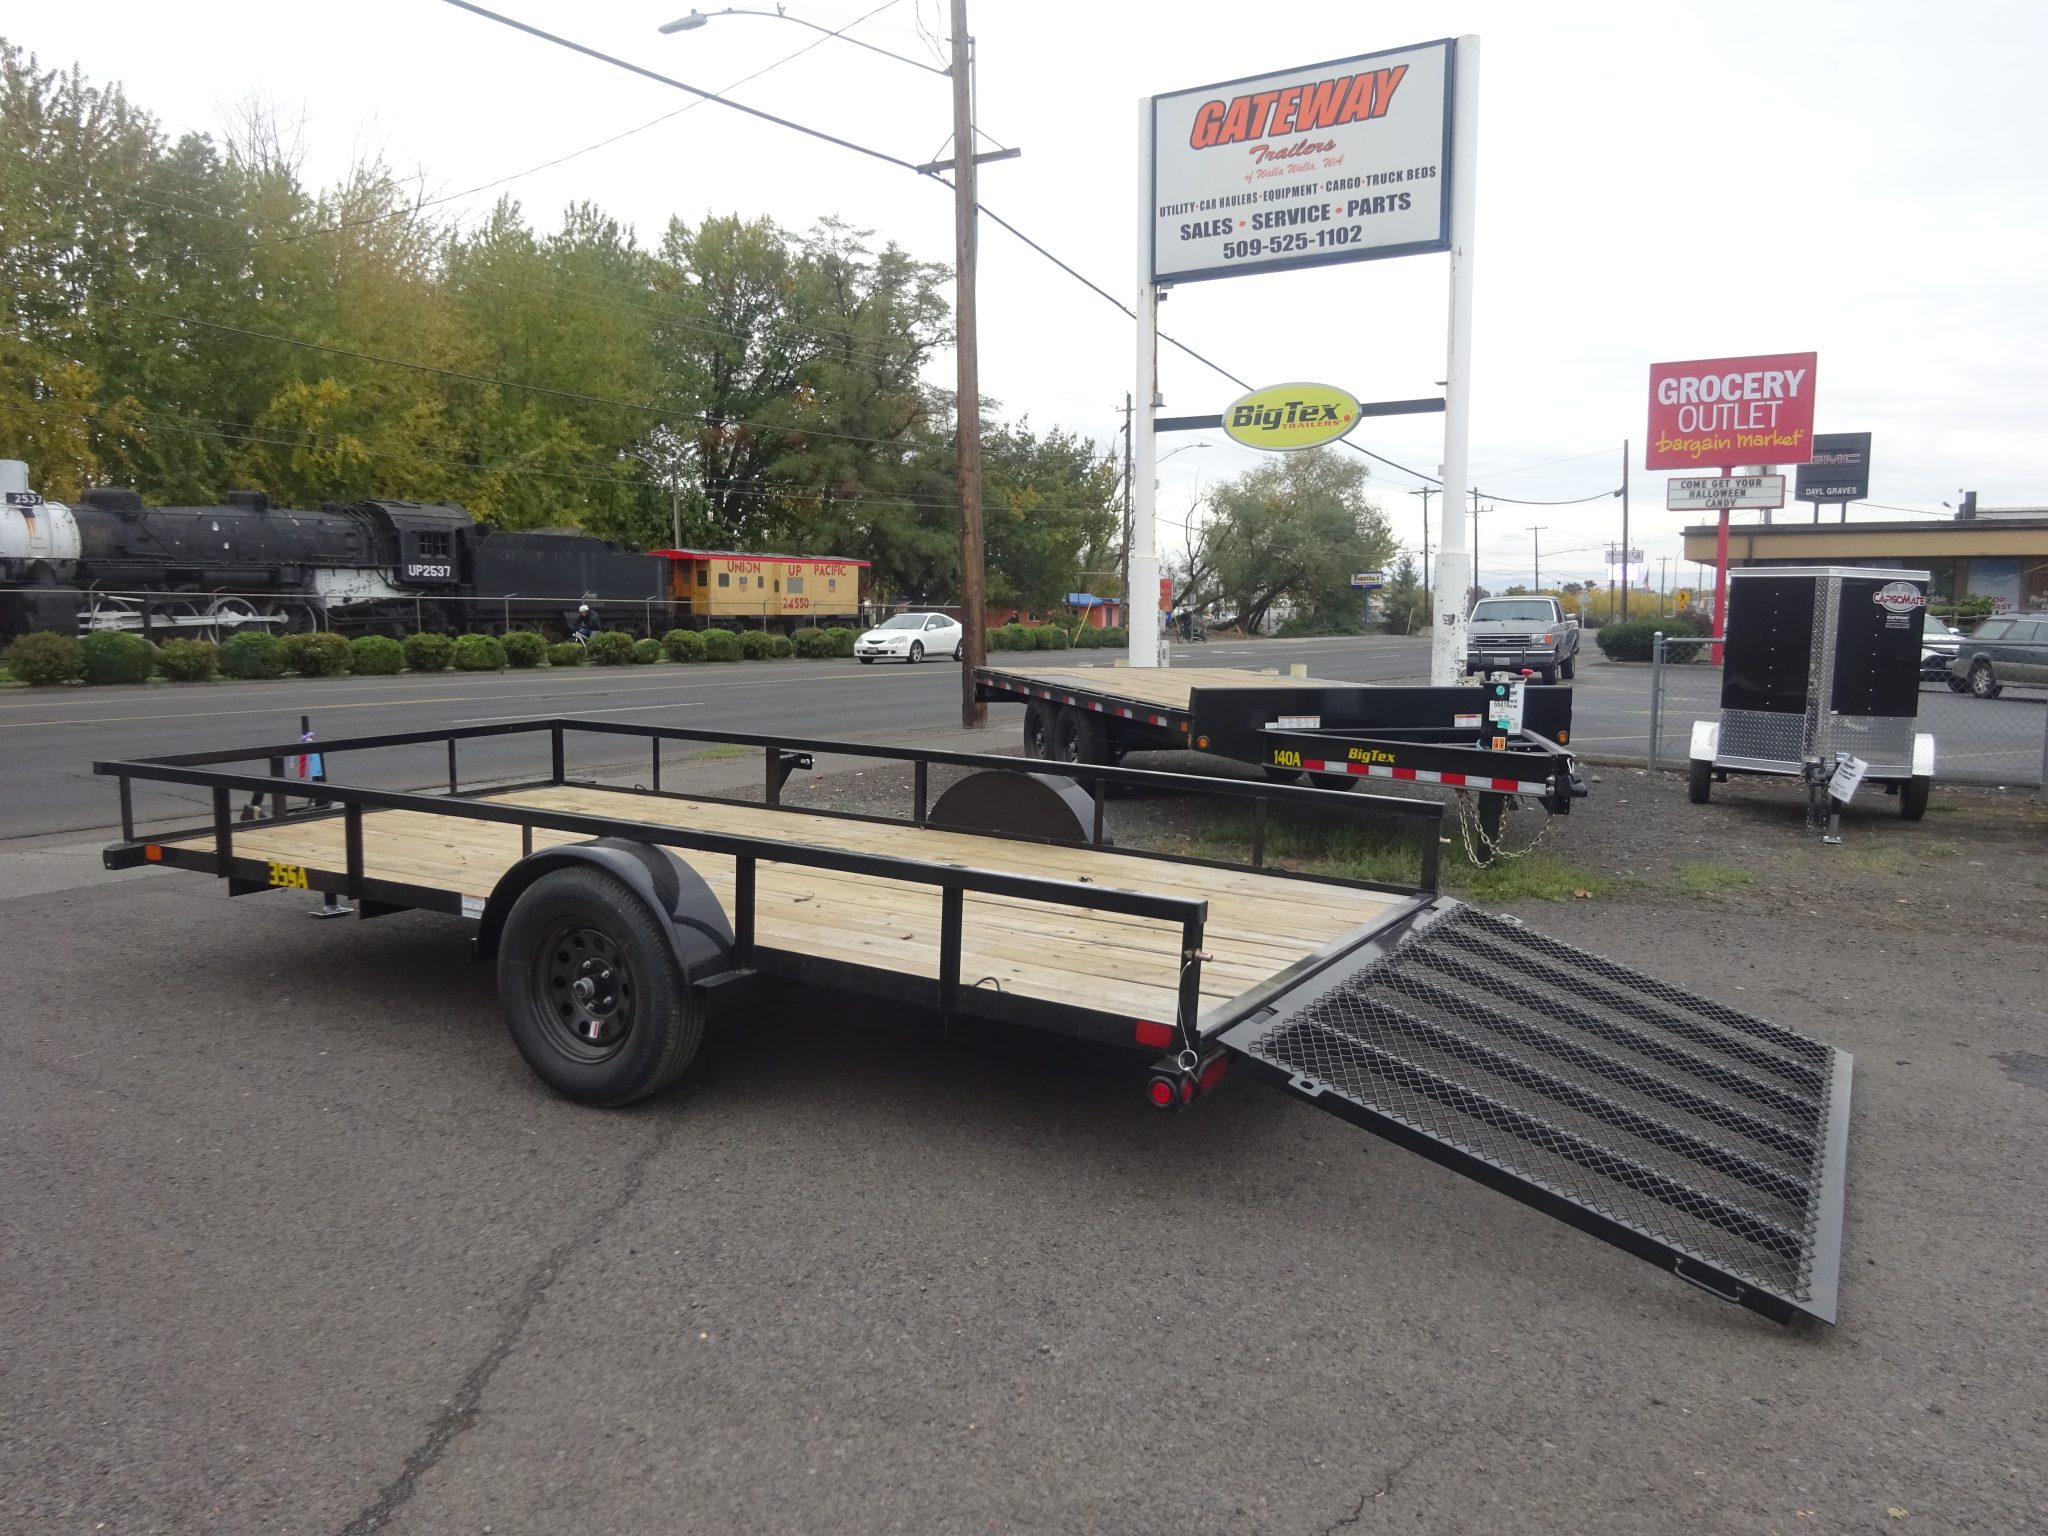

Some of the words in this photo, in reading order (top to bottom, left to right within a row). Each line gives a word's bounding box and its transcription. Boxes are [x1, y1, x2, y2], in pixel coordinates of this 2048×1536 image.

[1190, 64, 1409, 150] GATEWAY
[1249, 139, 1336, 165] Trailers
[1244, 170, 1254, 184] of
[1256, 167, 1284, 179] Walla
[1323, 155, 1344, 168] WA
[1159, 201, 1195, 217] UTILITY
[1199, 199, 1217, 211] CAR
[1219, 192, 1258, 209] HAULERS
[1263, 183, 1319, 202] EQUIPMENT
[1326, 176, 1361, 192] CARGO
[1366, 170, 1404, 187] TRUCK
[1406, 165, 1437, 181] BEDS
[1180, 217, 1233, 241] SALES
[1251, 203, 1331, 231] SERVICE
[1347, 192, 1411, 217] PARTS
[1223, 225, 1363, 260] 509-525-1102
[1657, 368, 1806, 405] GROCERY
[1232, 401, 1341, 430] BigTex
[1282, 419, 1340, 430] TRAILERS
[1678, 400, 1783, 433] OUTLET
[1655, 430, 1731, 459] bargain
[1736, 429, 1803, 447] market
[1811, 453, 1861, 465] GMC
[1680, 480, 1707, 489] COME
[1711, 479, 1730, 488] GET
[1736, 478, 1762, 488] YOUR
[1805, 487, 1825, 496] DAYL
[1826, 486, 1857, 495] GRAVES
[14, 494, 42, 504] 2537
[1689, 488, 1747, 498] HALLOWEEN
[1705, 499, 1736, 508] CANDY
[408, 564, 451, 577] UP2537
[727, 560, 761, 574] UNION
[788, 564, 802, 576] UP
[813, 564, 847, 577] PACIFIC
[782, 597, 810, 609] 24550
[1273, 749, 1301, 767] 140A
[1347, 747, 1396, 763] BigTex
[269, 861, 309, 889] 355A
